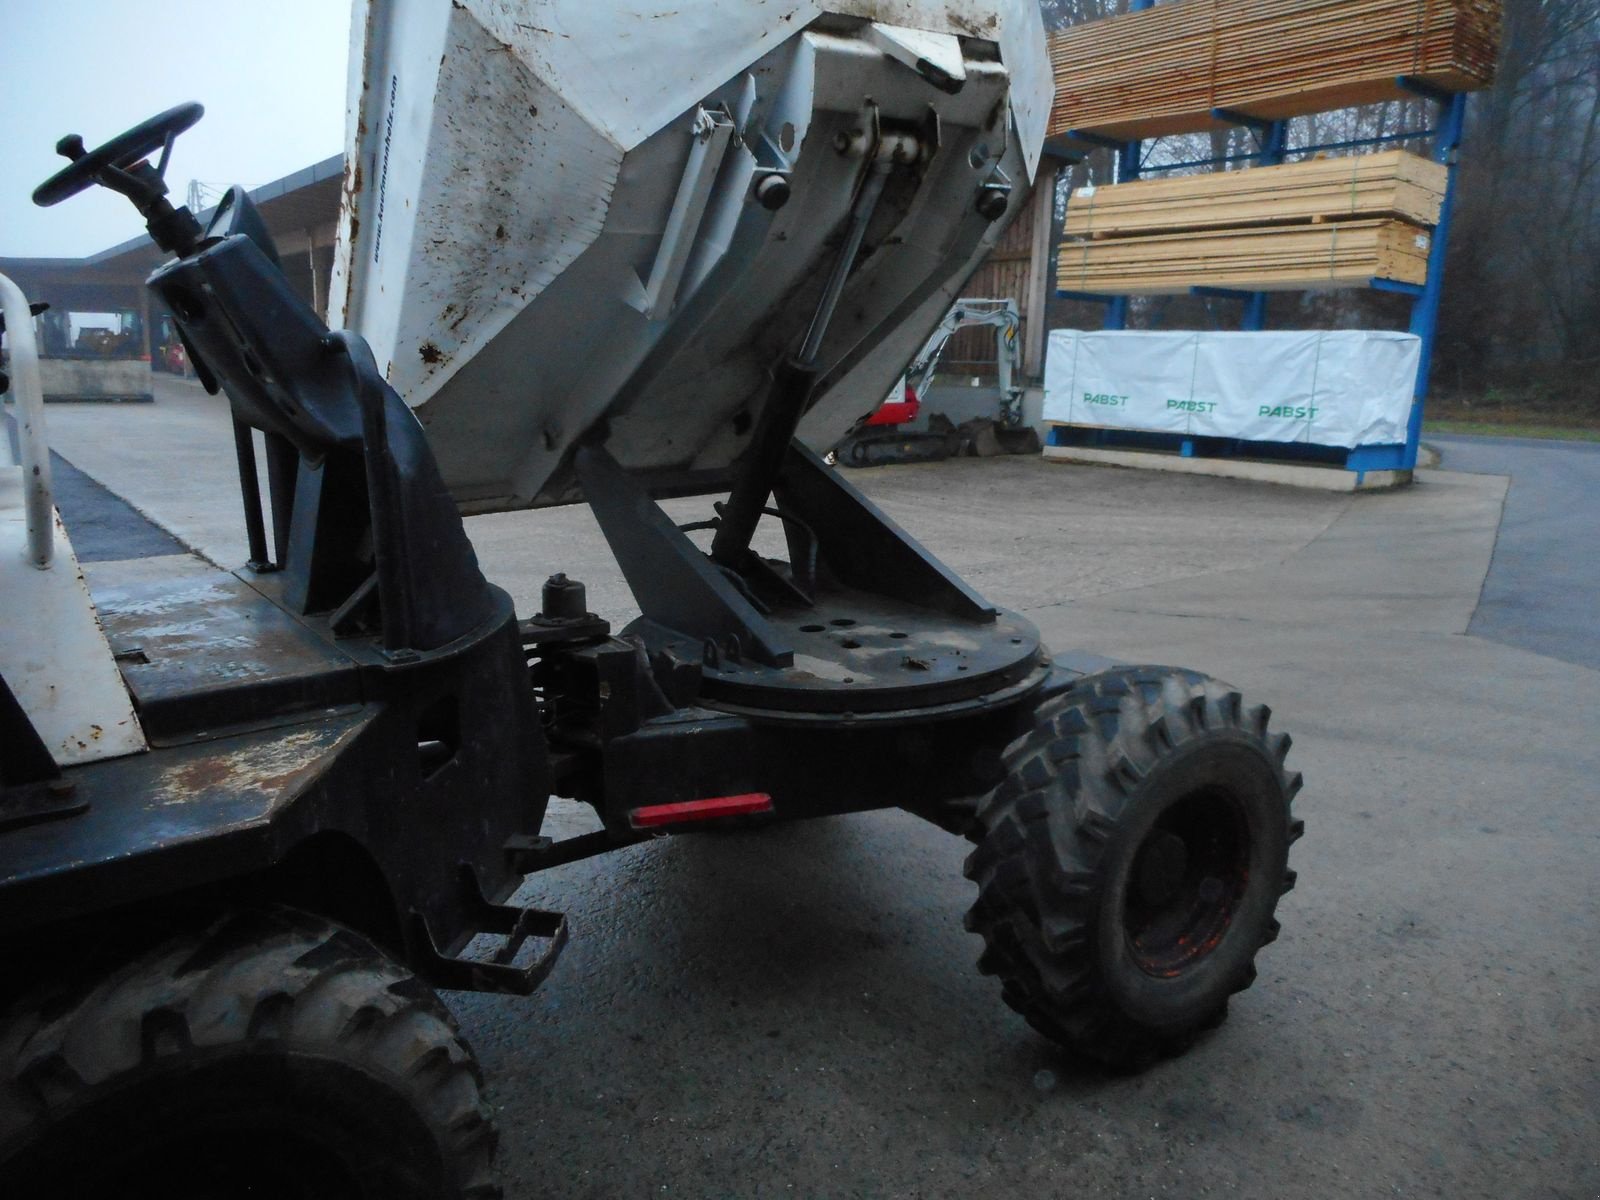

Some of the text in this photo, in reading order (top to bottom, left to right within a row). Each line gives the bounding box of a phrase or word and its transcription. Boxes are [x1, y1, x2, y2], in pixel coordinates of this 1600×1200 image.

[374, 74, 398, 264] www.kaufmannholz.com
[1083, 392, 1129, 406] PABST
[1166, 399, 1217, 413] PABST
[1258, 405, 1319, 419] PABST
